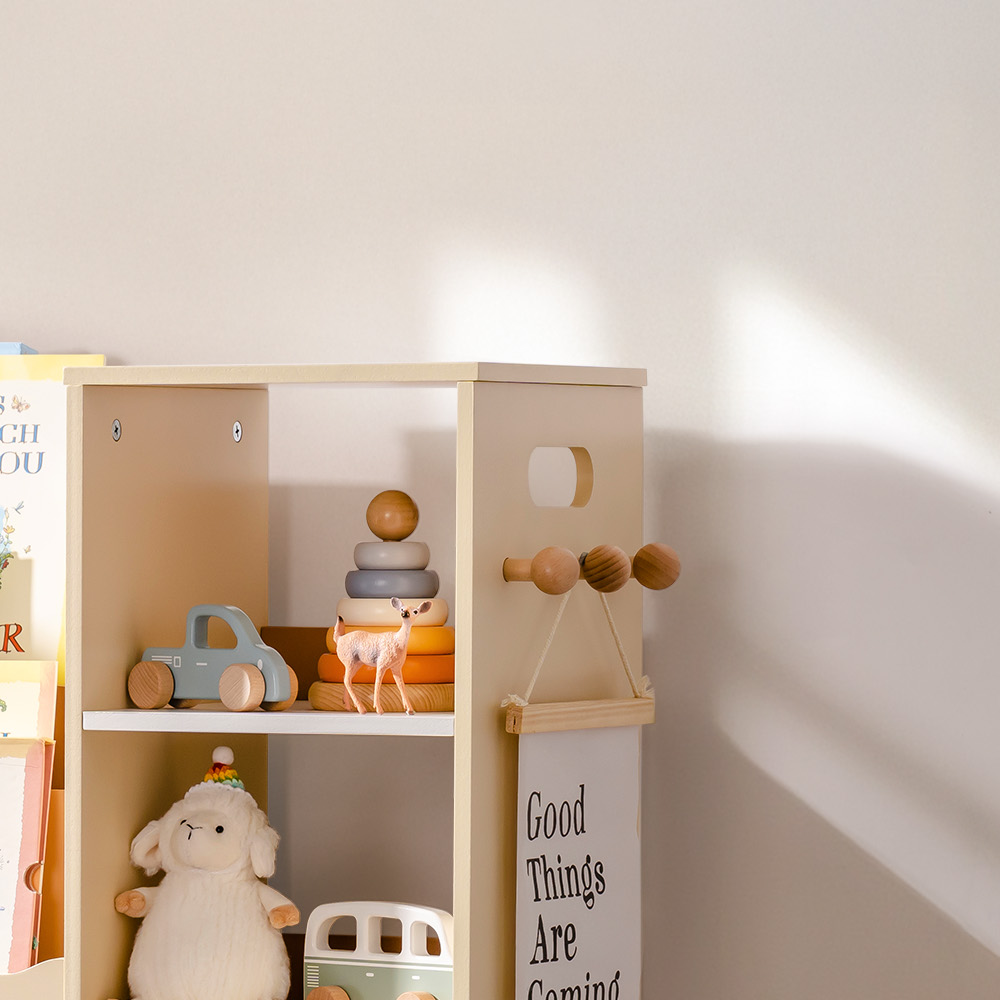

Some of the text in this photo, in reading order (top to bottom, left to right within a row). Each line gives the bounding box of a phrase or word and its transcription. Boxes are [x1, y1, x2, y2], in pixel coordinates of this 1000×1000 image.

[526, 784, 586, 841] Good
[526, 854, 606, 909] Things
[529, 914, 578, 965] Are
